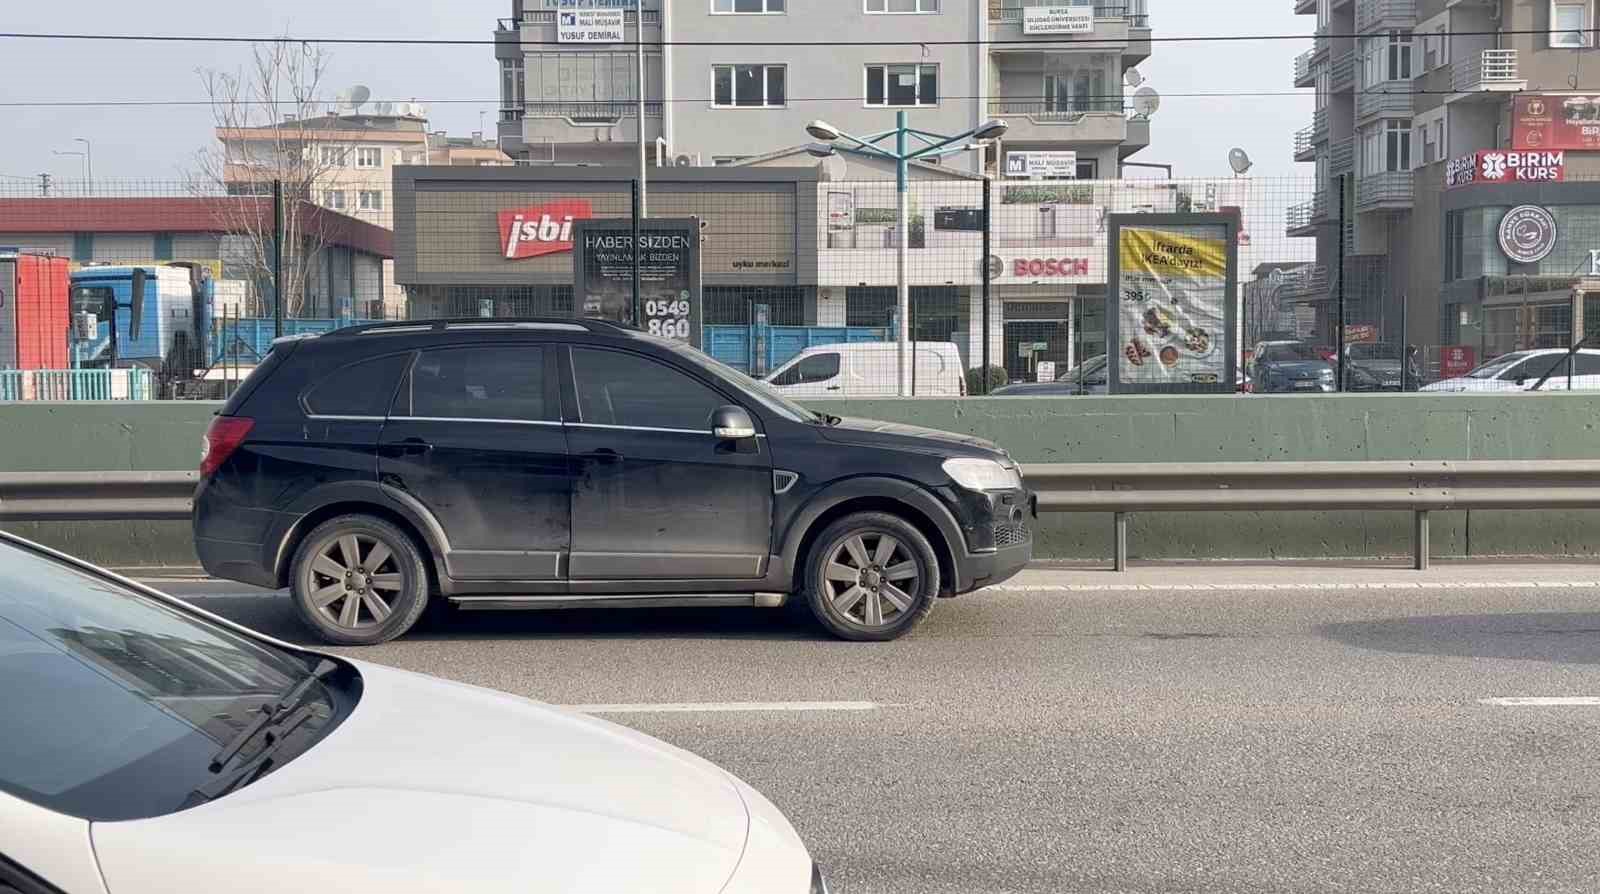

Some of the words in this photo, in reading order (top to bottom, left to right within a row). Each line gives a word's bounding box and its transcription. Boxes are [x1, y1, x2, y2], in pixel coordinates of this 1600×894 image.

[561, 31, 585, 40] YUSUF
[1516, 167, 1558, 179] KURS
[585, 236, 632, 248] HABER
[1013, 258, 1089, 276] BOSCH
[645, 300, 690, 316] 0549
[648, 318, 690, 338] 860
